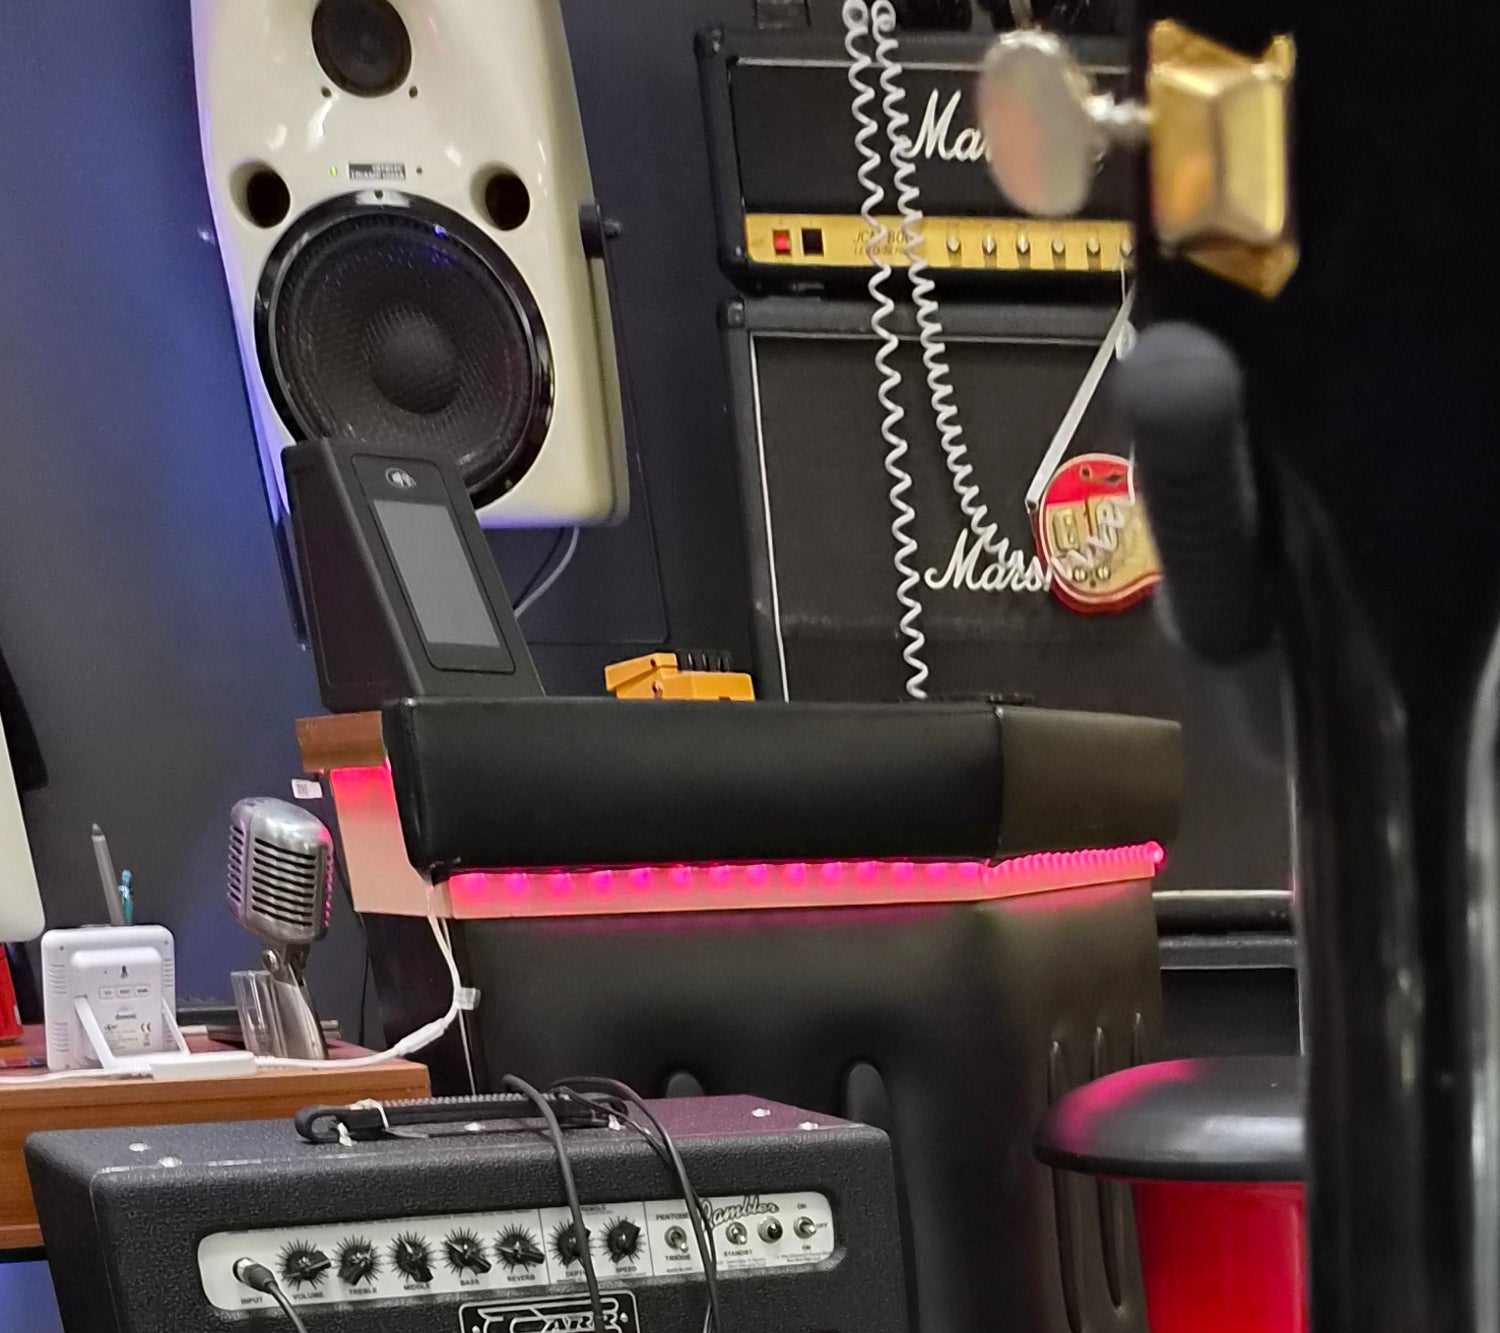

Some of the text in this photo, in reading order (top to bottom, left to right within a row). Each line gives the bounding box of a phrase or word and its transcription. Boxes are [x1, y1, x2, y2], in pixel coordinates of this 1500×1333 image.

[924, 528, 1051, 593] Mars
[507, 1274, 536, 1282] REVERB
[460, 1279, 480, 1287] BASS
[292, 1291, 325, 1301] VOLUME
[349, 1287, 377, 1296] TREBLE
[240, 1296, 263, 1305] INPUT
